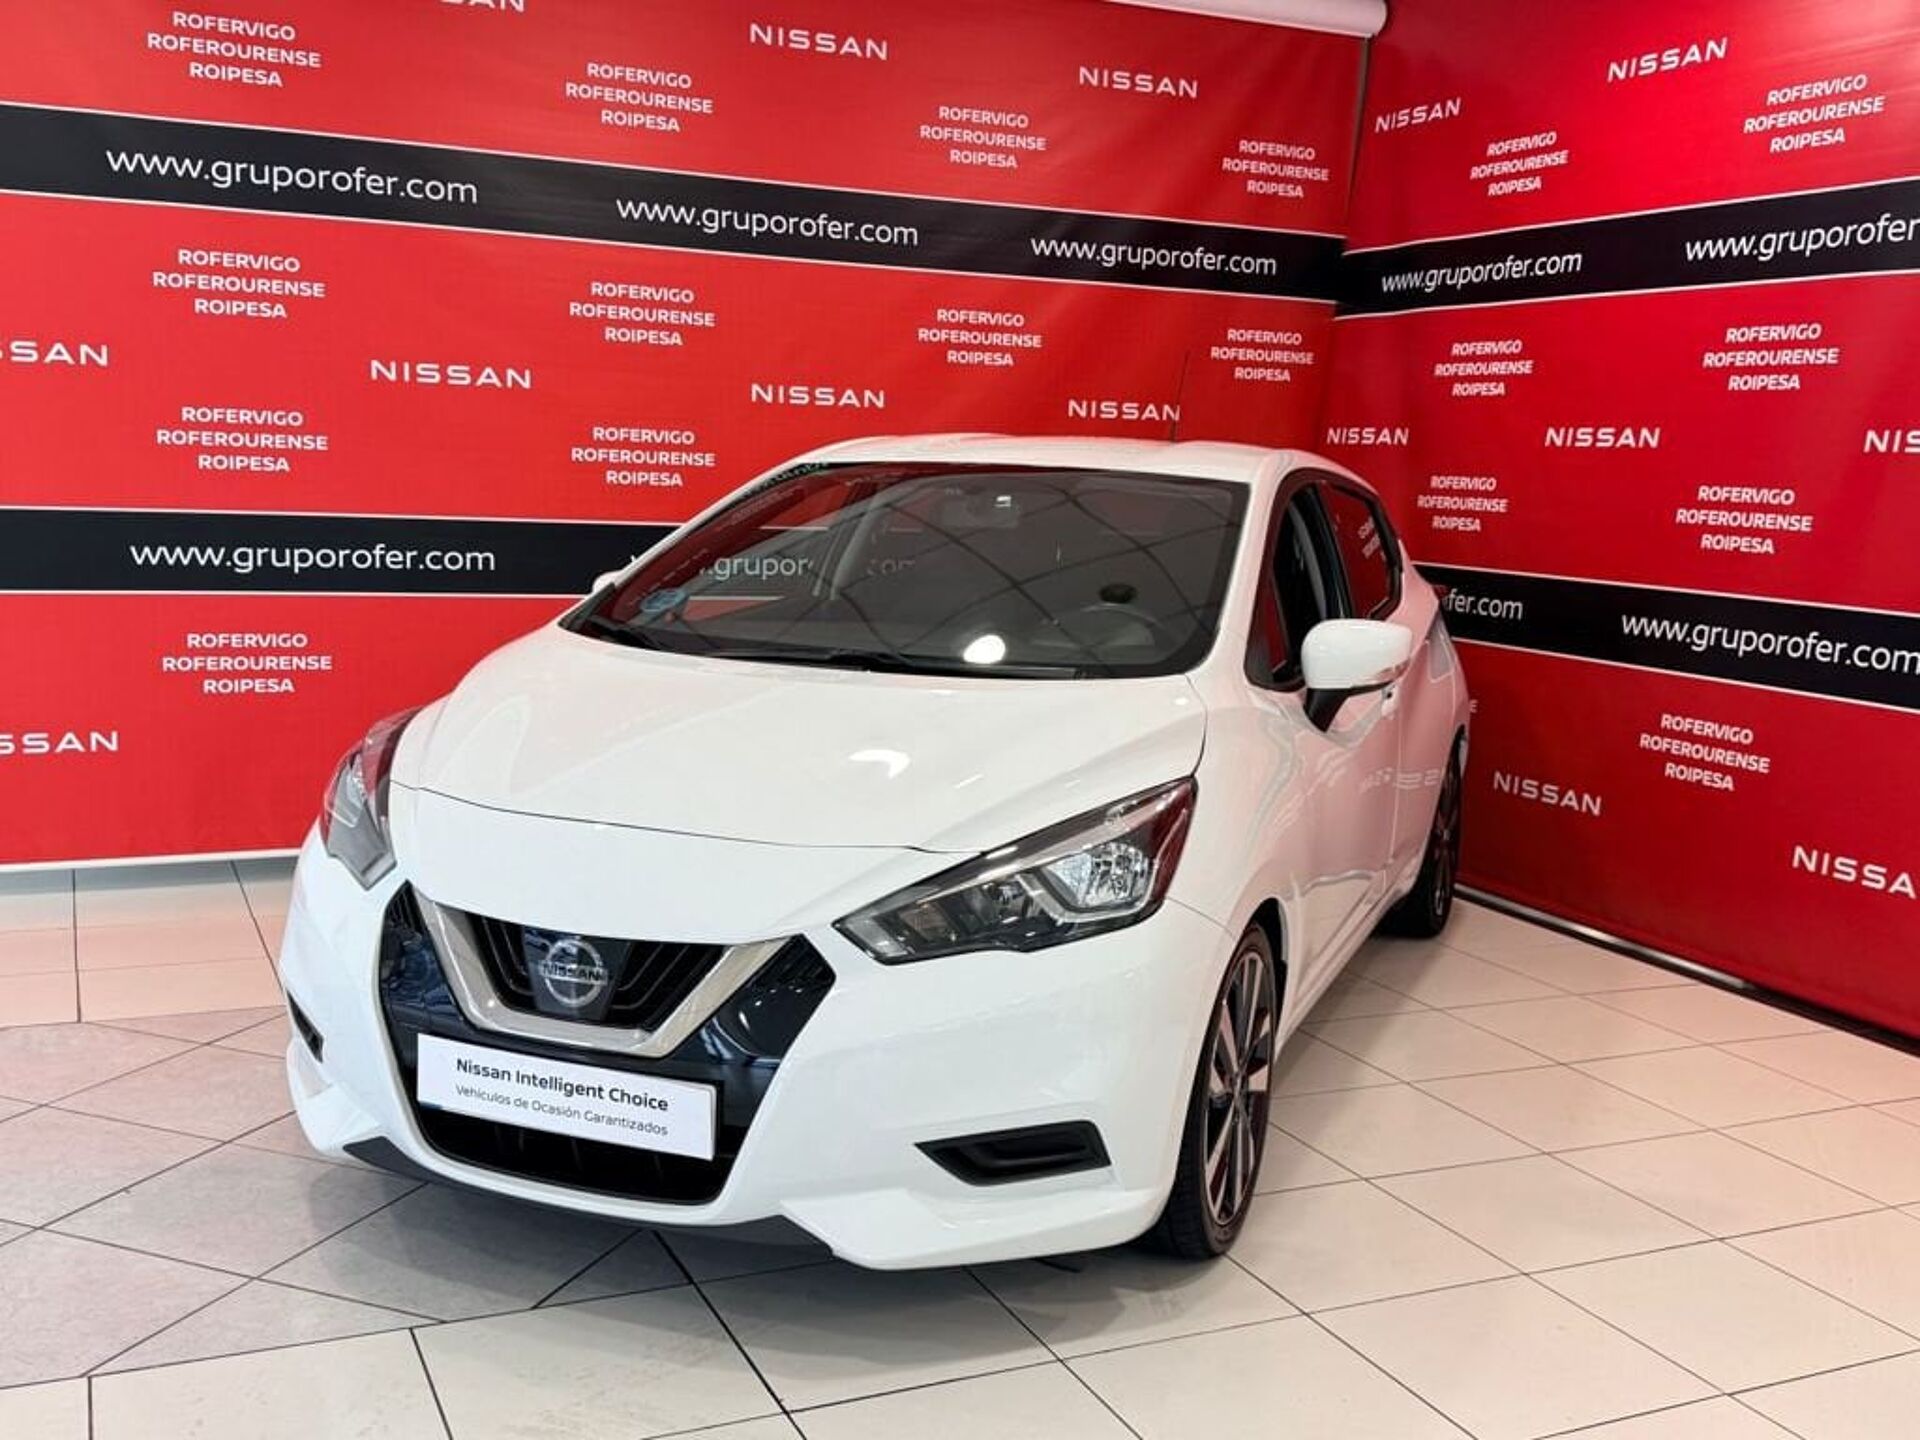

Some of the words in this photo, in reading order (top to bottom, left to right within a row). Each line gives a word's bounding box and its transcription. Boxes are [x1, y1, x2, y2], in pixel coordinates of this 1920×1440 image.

[172, 11, 296, 41] ROFERVIGO
[147, 32, 320, 68] ROFEROURENSE
[750, 23, 888, 61] NISSAN
[1608, 37, 1728, 81] NISSAN
[189, 61, 282, 87] ROIPESA
[587, 62, 692, 89] ROFERVIGO
[1079, 66, 1198, 98] NISSAN
[565, 82, 713, 114] ROFEROURENSE
[1767, 73, 1868, 105] ROFERVIGO
[601, 109, 680, 132] ROIPESA
[939, 106, 1029, 128] ROFERVIGO
[1375, 97, 1461, 133] NISSAN
[1744, 95, 1885, 133] ROFEROURENSE
[920, 125, 1046, 151] ROFEROURENSE
[1487, 131, 1557, 156] ROFERVIGO
[1770, 127, 1845, 152] ROIPESA
[950, 149, 1018, 168] ROIPESA
[1239, 139, 1316, 160] ROFERVIGO
[1222, 157, 1328, 181] ROFEROURENSE
[1471, 150, 1568, 178] ROFEROURENSE
[106, 150, 478, 204] www.gruporofer.com
[1488, 176, 1542, 196] ROIPESA
[1246, 179, 1304, 198] ROIPESA
[616, 199, 918, 246] www.gruporofer.com
[178, 248, 301, 273] ROFERVIGO
[1030, 237, 1277, 275] www.gruporofer.com
[153, 271, 325, 297] ROFEROURENSE
[1381, 253, 1583, 293] www.gruporofer.com
[591, 282, 694, 303] ROFERVIGO
[194, 298, 287, 318] ROIPESA
[569, 302, 715, 327] ROFEROURENSE
[936, 308, 1025, 327] ROFERVIGO
[604, 326, 683, 346] ROIPESA
[918, 327, 1041, 348] ROFEROURENSE
[1227, 328, 1302, 345] ROFERVIGO
[1726, 323, 1822, 343] ROFERVIGO
[0, 340, 108, 366] SAN
[947, 350, 1014, 366] ROIPESA
[1210, 346, 1313, 365] ROFEROURENSE
[1452, 339, 1522, 356] ROFERVIGO
[1703, 348, 1839, 367] ROFEROURENSE
[370, 359, 531, 389] NISSAN
[1234, 366, 1291, 382] ROIPESA
[1435, 360, 1533, 376] ROFEROURENSE
[1452, 382, 1505, 396] ROIPESA
[1728, 374, 1801, 391] ROIPESA
[751, 383, 885, 408] NISSAN
[181, 406, 303, 427] ROFERVIGO
[1068, 399, 1180, 421] NISSAN
[156, 429, 327, 451] ROFEROURENSE
[592, 426, 695, 445] ROFERVIGO
[1327, 427, 1409, 445] NISSAN
[1544, 427, 1660, 448] NISSAN
[198, 454, 290, 472] ROIPESA
[571, 447, 714, 466] ROFEROURENSE
[606, 470, 683, 486] ROIPESA
[1431, 475, 1497, 491] ROFERVIGO
[1417, 495, 1508, 513] ROFEROURENSE
[1698, 485, 1795, 506] ROFERVIGO
[1432, 515, 1481, 532] ROIPESA
[1676, 508, 1813, 532] ROFEROURENSE
[1701, 533, 1775, 554] ROIPESA
[129, 543, 495, 574] www.gruporofer.com
[187, 633, 308, 648] ROFERVIGO
[1622, 614, 1920, 675] www.gruporofer.com
[162, 655, 332, 672] ROFEROURENSE
[203, 678, 295, 694] ROIPESA
[1660, 714, 1754, 745] ROFERVIGO
[1640, 733, 1771, 774] ROFEROURENSE
[1664, 762, 1734, 791] ROIPESA
[1493, 771, 1602, 816] NISSAN
[543, 963, 604, 983] NISSAN
[456, 1058, 511, 1081] Nissan
[515, 1070, 605, 1100] Intelligent
[608, 1088, 669, 1111] Choice
[513, 1097, 529, 1110] de
[583, 1109, 669, 1136] Garantizados
